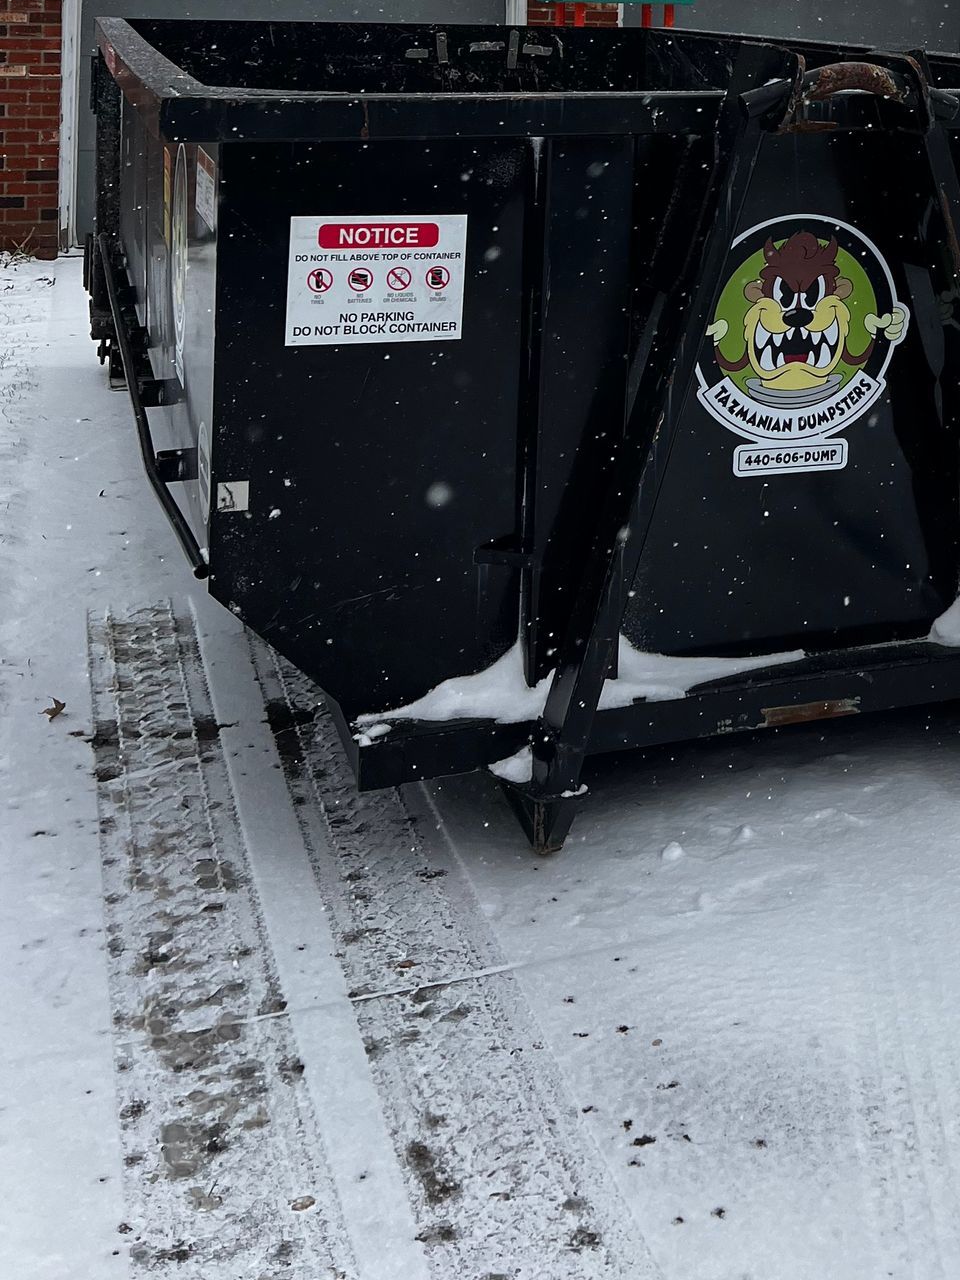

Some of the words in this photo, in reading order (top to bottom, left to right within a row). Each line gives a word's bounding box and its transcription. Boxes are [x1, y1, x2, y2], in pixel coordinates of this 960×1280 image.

[339, 227, 419, 245] NOTICE
[295, 254, 309, 262] DO
[310, 254, 329, 262] NOT
[331, 254, 349, 262] FILL
[350, 253, 380, 261] ABOVE
[381, 253, 399, 261] TOP
[413, 252, 461, 260] CONTAINER
[339, 313, 358, 323] NO
[360, 311, 415, 322] PARKING
[293, 326, 312, 337] DO
[314, 325, 341, 336] NOT
[343, 323, 387, 335] BLOCK
[389, 321, 457, 334] CONTAINER
[714, 385, 793, 433] TAZMANIAN
[798, 378, 872, 432] DUMPSTERS
[744, 449, 837, 466] 440-606-DUMP
